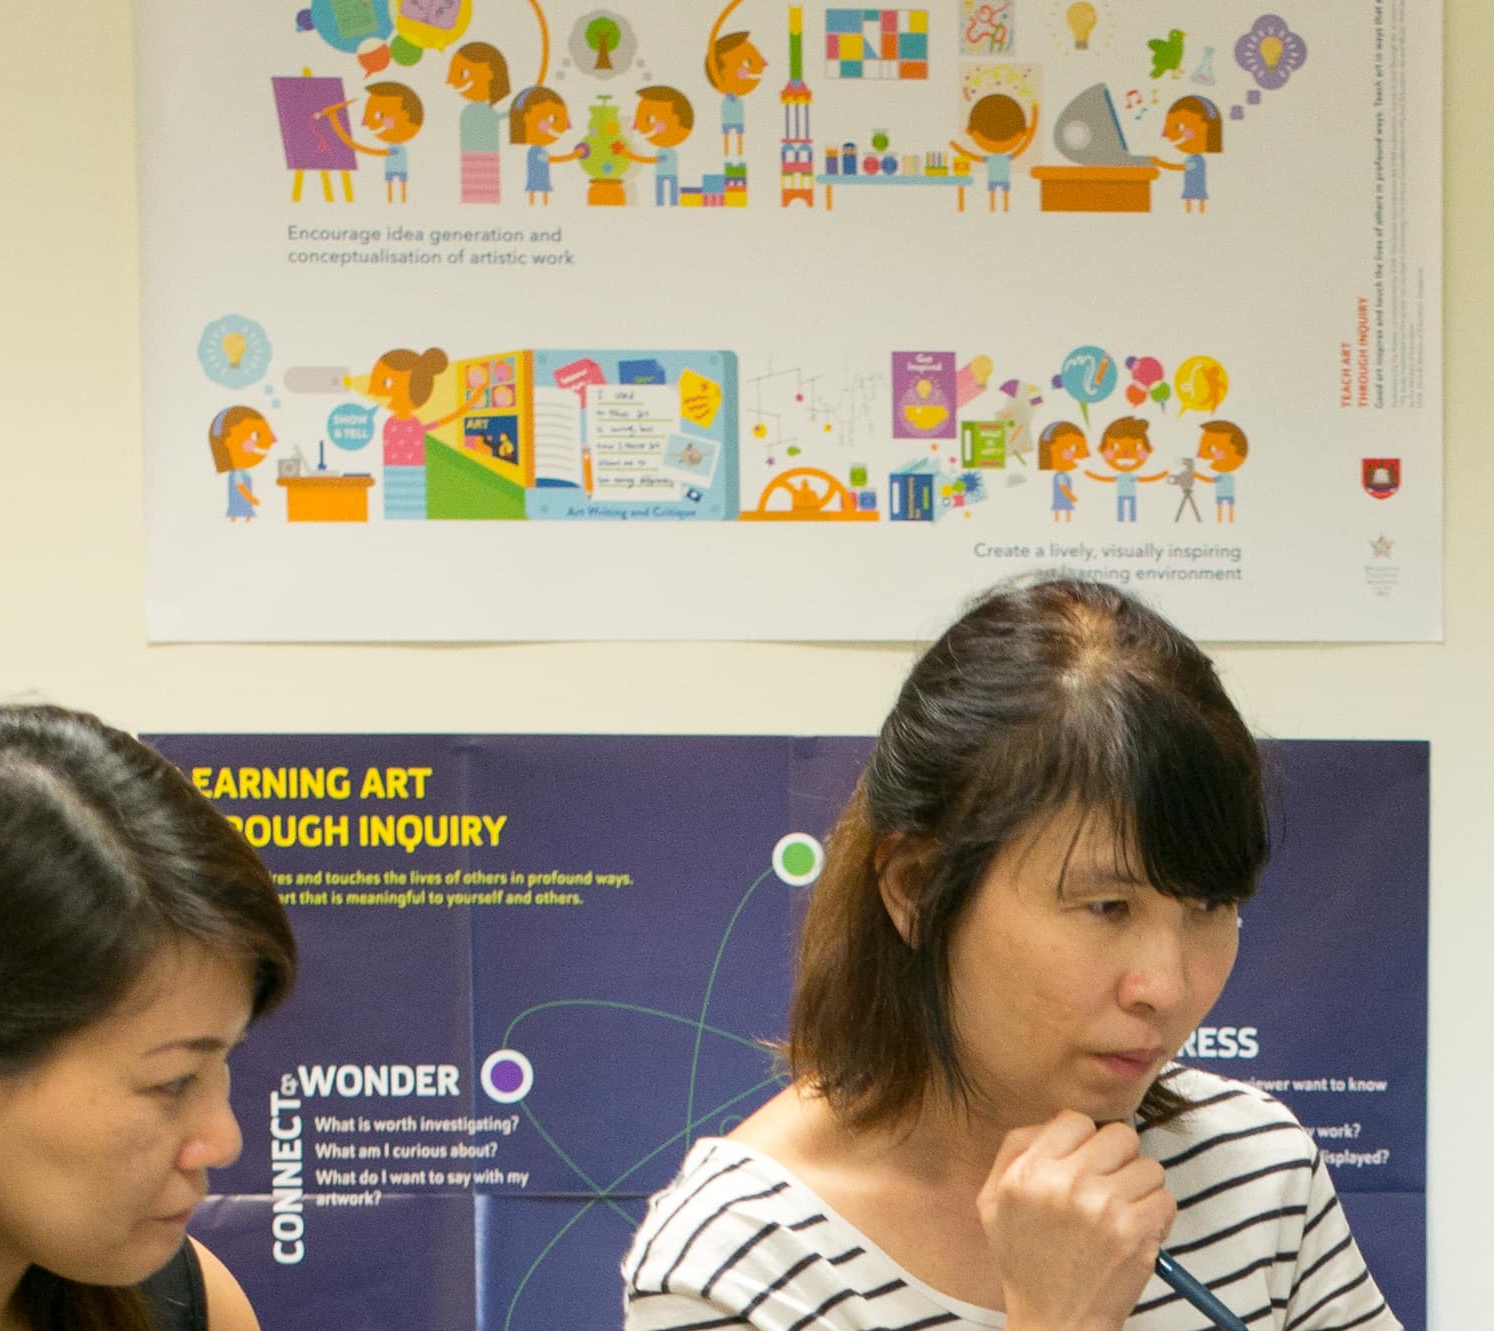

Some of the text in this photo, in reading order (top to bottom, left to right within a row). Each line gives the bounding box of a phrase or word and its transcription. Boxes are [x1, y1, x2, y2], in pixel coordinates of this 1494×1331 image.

[287, 225, 561, 246] Encourage idea generation and
[288, 248, 574, 266] conceptualisation of artistic work
[466, 418, 489, 430] ART
[974, 542, 1241, 562] Create a lively, visually inspiring
[1136, 568, 1242, 581] environment
[192, 767, 350, 798] EARNING
[225, 814, 507, 853] OUGH INQUIRY
[1292, 1077, 1387, 1091] want to know
[314, 1115, 519, 1135] What is worth investigating?
[1317, 1123, 1361, 1138] work?
[315, 1142, 497, 1158] What am I curious about?
[270, 1064, 460, 1265] CONNECT & WONDER
[315, 1168, 528, 1187] What do I want to say with my
[316, 1191, 383, 1206] artwork?
